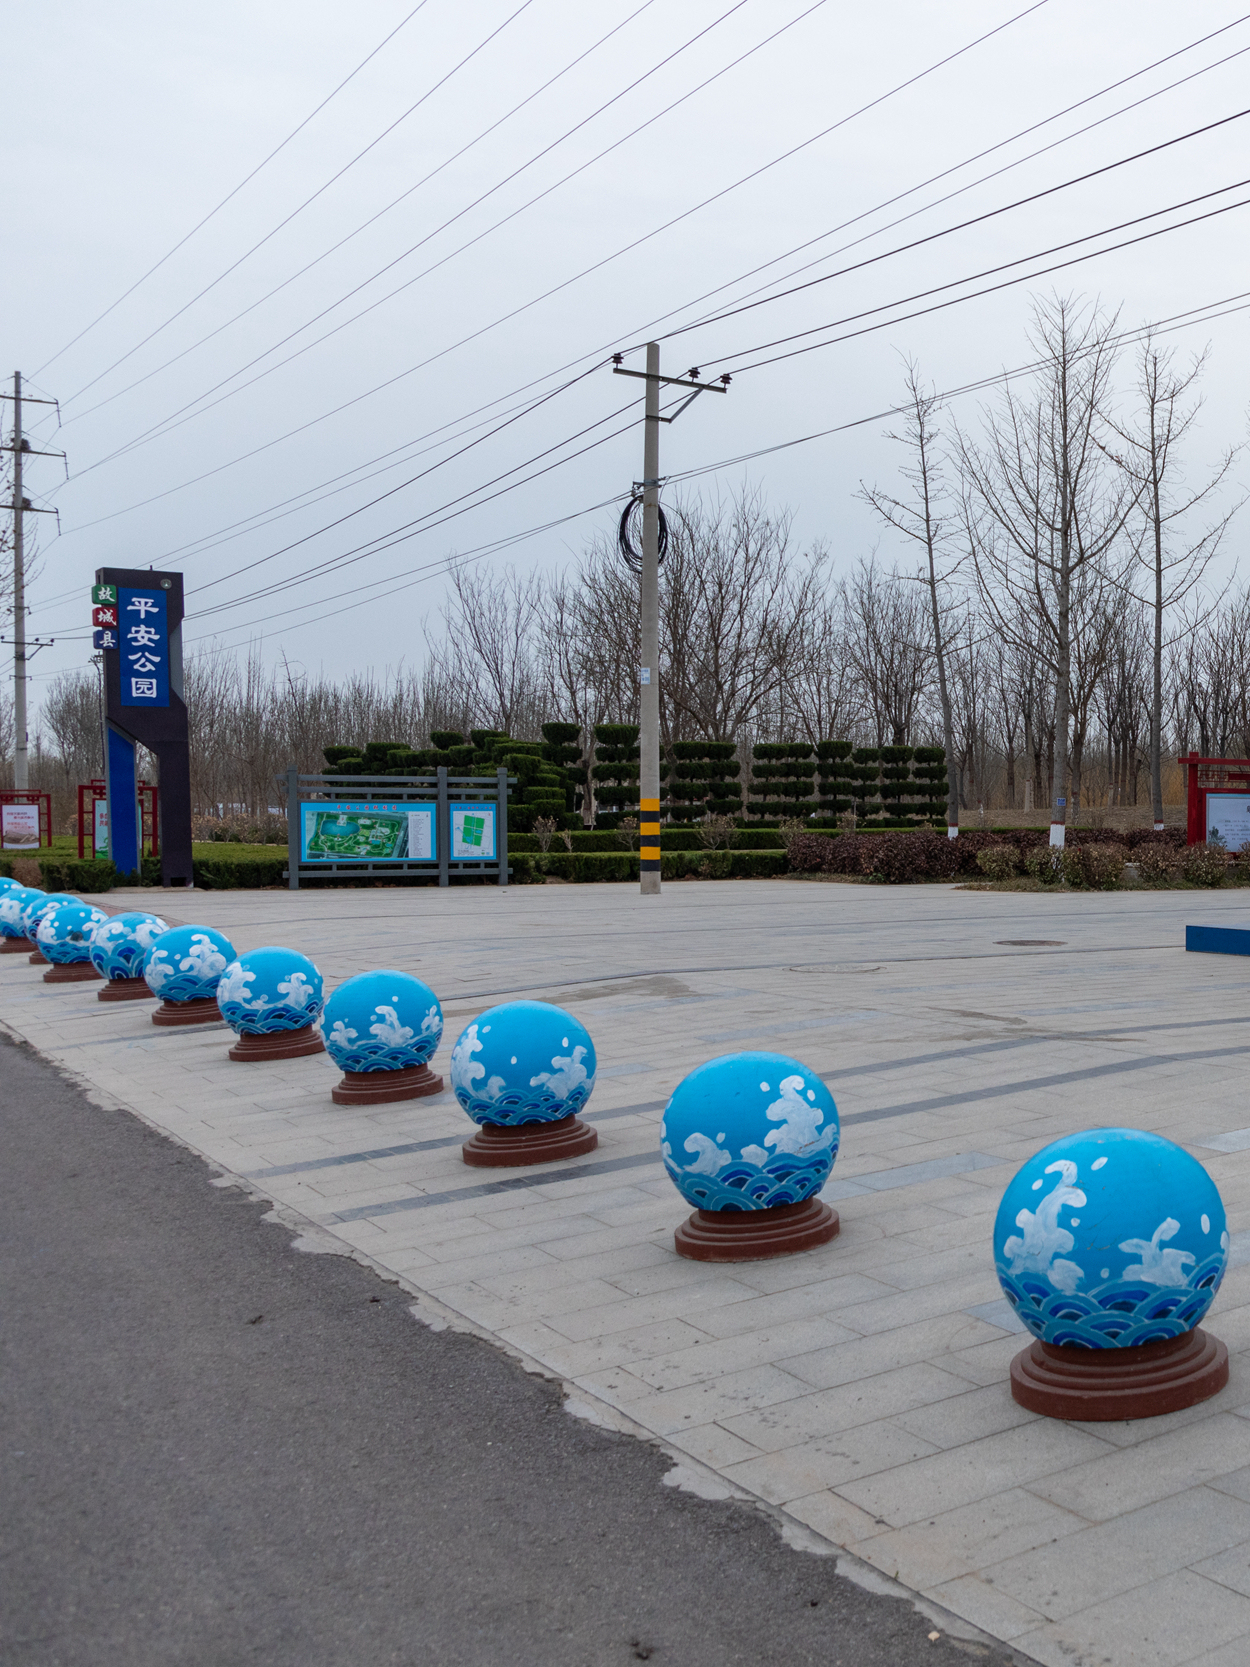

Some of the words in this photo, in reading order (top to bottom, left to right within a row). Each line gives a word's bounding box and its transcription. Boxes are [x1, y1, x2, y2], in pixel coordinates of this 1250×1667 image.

[98, 586, 117, 647] 故城县
[127, 598, 161, 698] 平安公园
